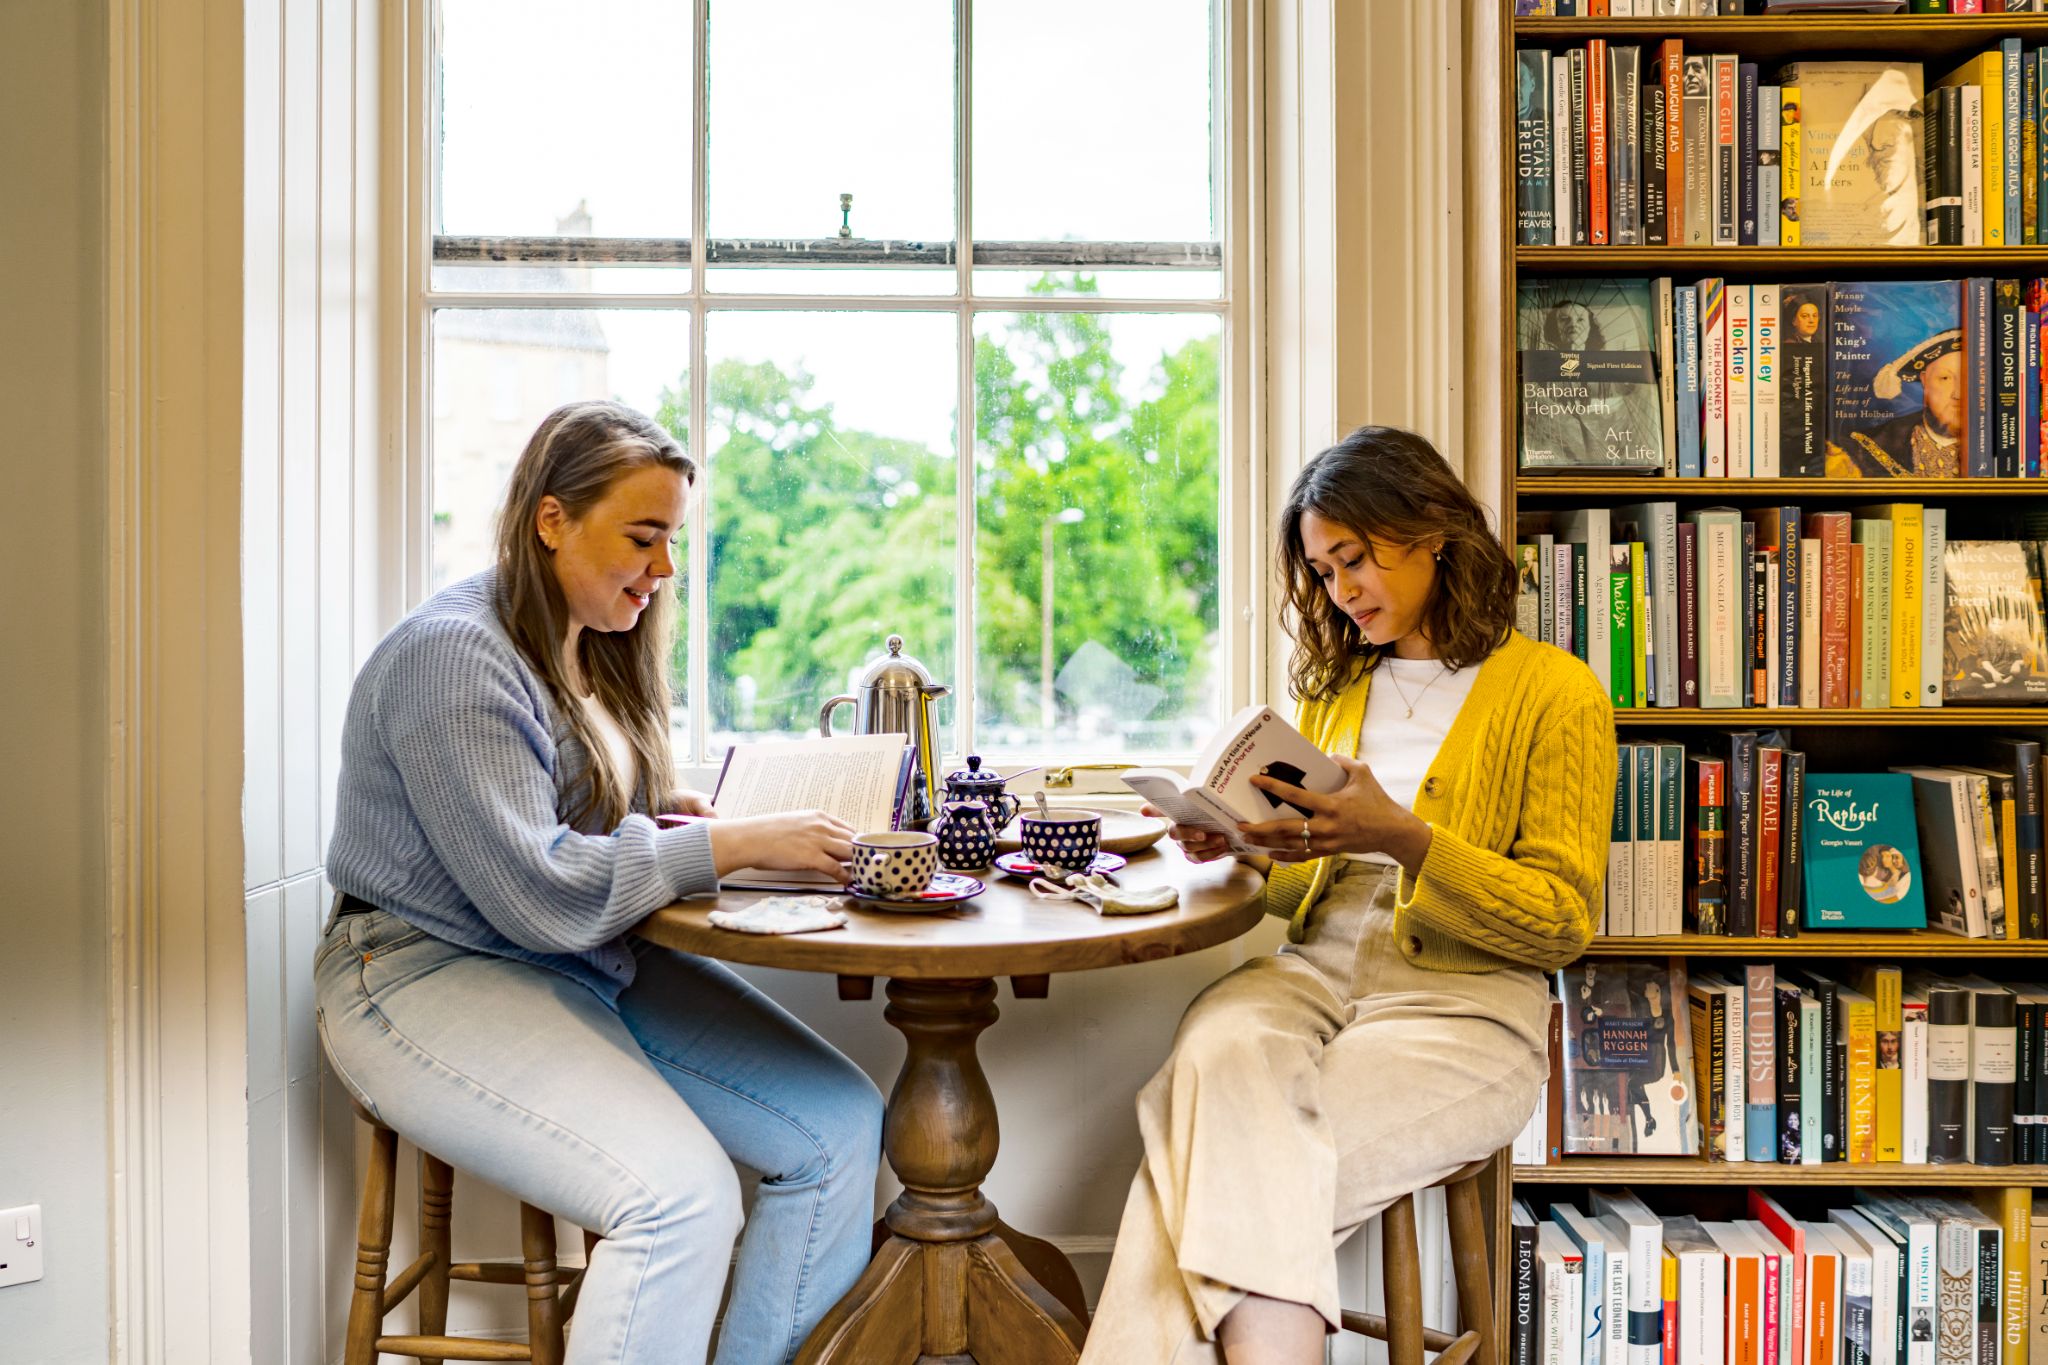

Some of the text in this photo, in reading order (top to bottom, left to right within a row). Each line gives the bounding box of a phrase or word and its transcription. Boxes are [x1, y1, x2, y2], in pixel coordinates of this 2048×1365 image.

[2008, 52, 2018, 70] THE
[1575, 70, 1583, 110] WILLIAM
[1670, 54, 1679, 152] THE GAUGUIN ATLAS
[1721, 67, 1731, 139] ERIC GILL
[2008, 72, 2018, 116] VINCENT
[1575, 112, 1583, 153] POWELL
[1591, 102, 1604, 166] Terry Frost
[1645, 119, 1653, 152] Portrait
[1656, 90, 1665, 170] GAINSBOROUGH
[1971, 100, 1979, 168] VAN GOGH'S EAR
[2008, 116, 2018, 134] VAN
[1519, 120, 1531, 177] FREUD
[1533, 120, 1544, 177] LUCIAN
[1575, 154, 1583, 180] FRITH
[1687, 138, 1695, 190] JAMES LORD
[2008, 137, 2018, 166] GOGH
[2008, 168, 2018, 196] ATLAS
[1519, 220, 1551, 228] FEAVER
[1834, 291, 1865, 301] Franny
[1834, 305, 1861, 314] Moyle
[1686, 291, 1697, 392] BARBARA HEPWORTH
[1834, 322, 1855, 332] The
[1834, 336, 1866, 347] King's
[1730, 319, 1748, 383] Hockney
[1758, 317, 1776, 382] Hockney
[1834, 351, 1870, 360] Painter
[2002, 314, 2013, 387] DAVID JONES
[1524, 383, 1588, 398] Barbara
[1793, 356, 1801, 398] Jenny Uglow
[1804, 356, 1812, 388] Hogarth:
[1835, 371, 1851, 379] The
[1835, 384, 1869, 393] Life and
[1525, 400, 1610, 418] Hepworth
[1804, 398, 1812, 411] Life
[1804, 413, 1812, 423] and
[1835, 397, 1870, 406] Times of
[1835, 410, 1894, 418] Hans Holbein
[1605, 427, 1632, 441] Art
[1606, 445, 1656, 459] & Life
[1804, 432, 1812, 453] World
[1666, 513, 1675, 597] DIVINE PEOPLE
[1716, 531, 1725, 612] MICHELANGELO
[1786, 521, 1796, 584] MOROZOV
[1905, 537, 1914, 567] JOHN
[1930, 525, 1938, 584] PAUL NASH
[1757, 584, 1765, 598] My
[1835, 517, 1847, 628] WILLIAM MORRIS
[1905, 569, 1914, 600] NASH
[1614, 576, 1629, 629] Matisse
[1757, 613, 1765, 630] Marc
[1929, 594, 1937, 646] OUTLINE
[1543, 619, 1552, 642] Dora
[1757, 632, 1765, 658] Chagall
[1785, 635, 1793, 687] SEMENOVA
[1210, 721, 1262, 789] What Artists Wear
[1216, 741, 1256, 794] Charlie Porter
[1740, 791, 1749, 810] John
[1764, 763, 1778, 836] RAPHAEL
[1817, 789, 1852, 797] The Life of
[1741, 814, 1749, 834] Piper
[1808, 798, 1879, 831] Raphael
[1740, 837, 1749, 876] Myfanwy
[1766, 851, 1774, 891] Forcellino
[1740, 879, 1749, 899] Piper
[1603, 1030, 1647, 1039] HANNAH
[1604, 1042, 1648, 1050] RYGGEN
[1733, 996, 1741, 1070] ALFRED STIEGLITZ
[1750, 976, 1774, 1082] STUBBS
[1787, 1011, 1798, 1083] Between Lives
[1713, 1009, 1723, 1092] SARGENT'S WOMEN
[1856, 1044, 1871, 1136] TURNER
[1921, 1246, 1929, 1302] WHISTLER
[1985, 1251, 1990, 1262] SO
[1518, 1240, 1531, 1325] LEONARDO
[1613, 1260, 1622, 1340] THE LAST LEONARDO
[1768, 1276, 1776, 1350] Andy Warhol Wayne
[2007, 1270, 2021, 1344] HILLIARD
